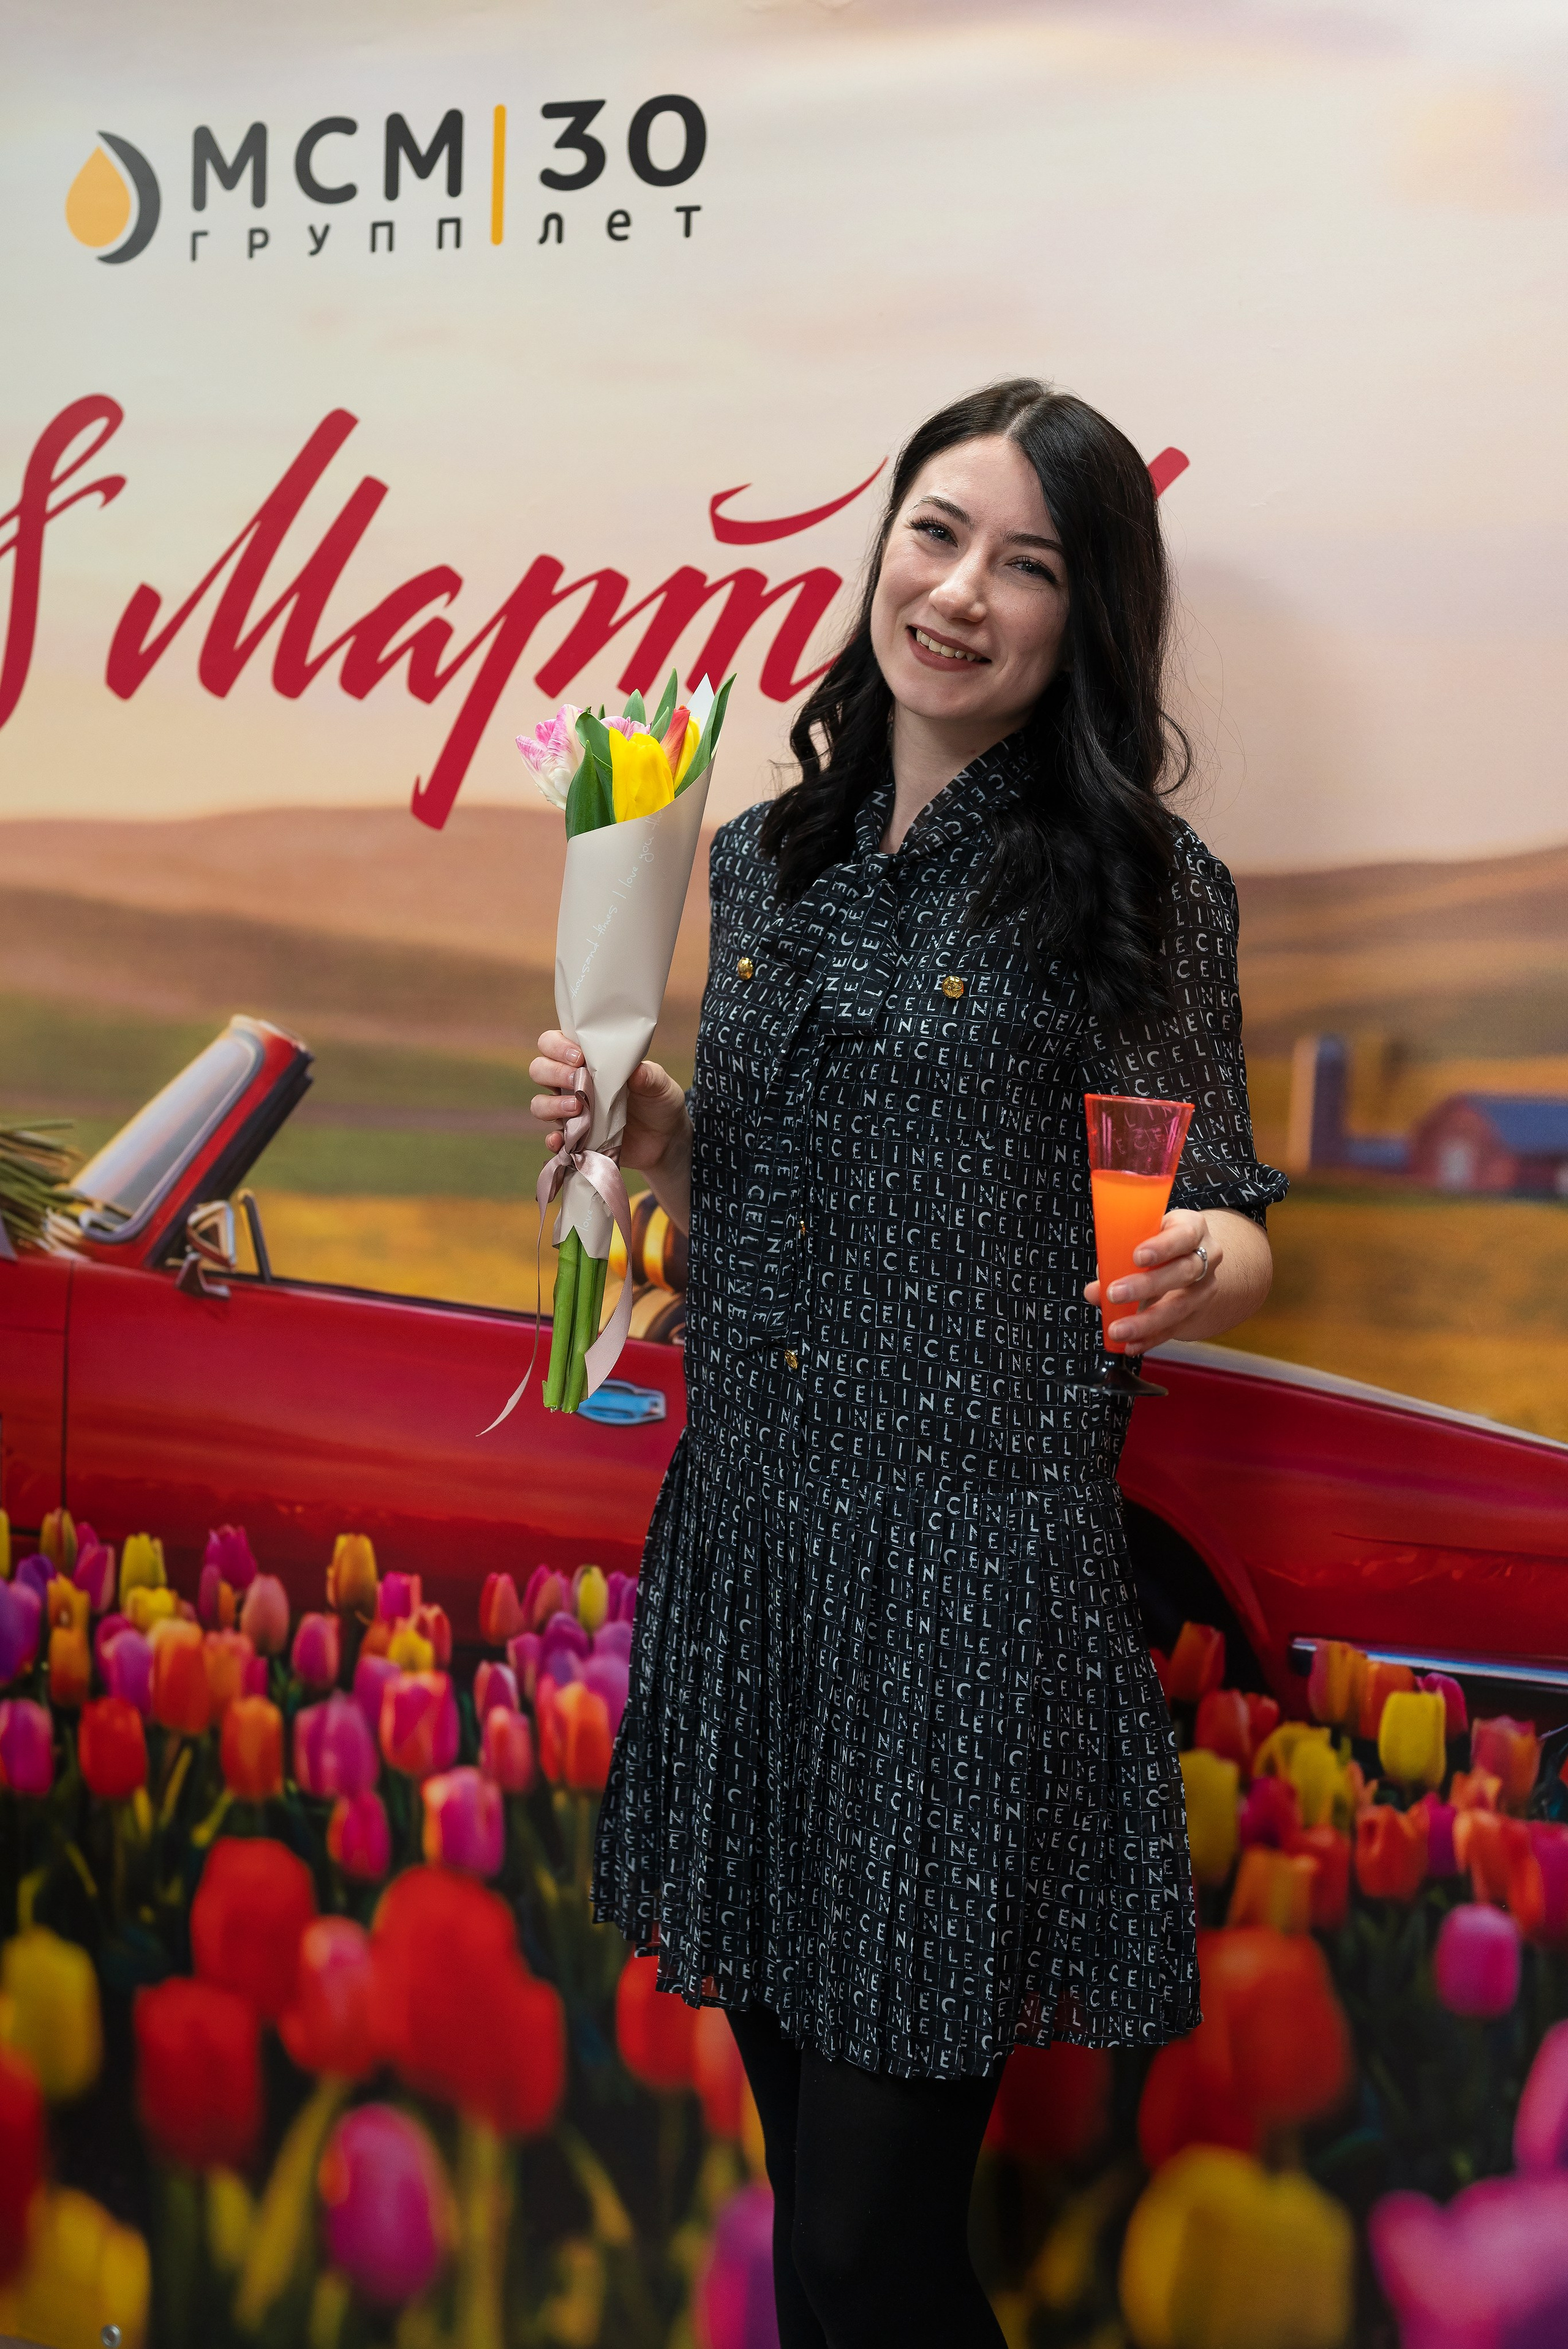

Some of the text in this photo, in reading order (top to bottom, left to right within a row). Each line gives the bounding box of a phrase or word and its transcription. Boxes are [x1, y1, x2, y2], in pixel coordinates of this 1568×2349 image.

[192, 93, 707, 212] МСМ 30
[190, 217, 462, 262] ГРУПП
[105, 409, 1189, 832] Март
[570, 938, 600, 999] thousand
[592, 905, 618, 937] times
[618, 866, 638, 888] love
[639, 836, 654, 862] you
